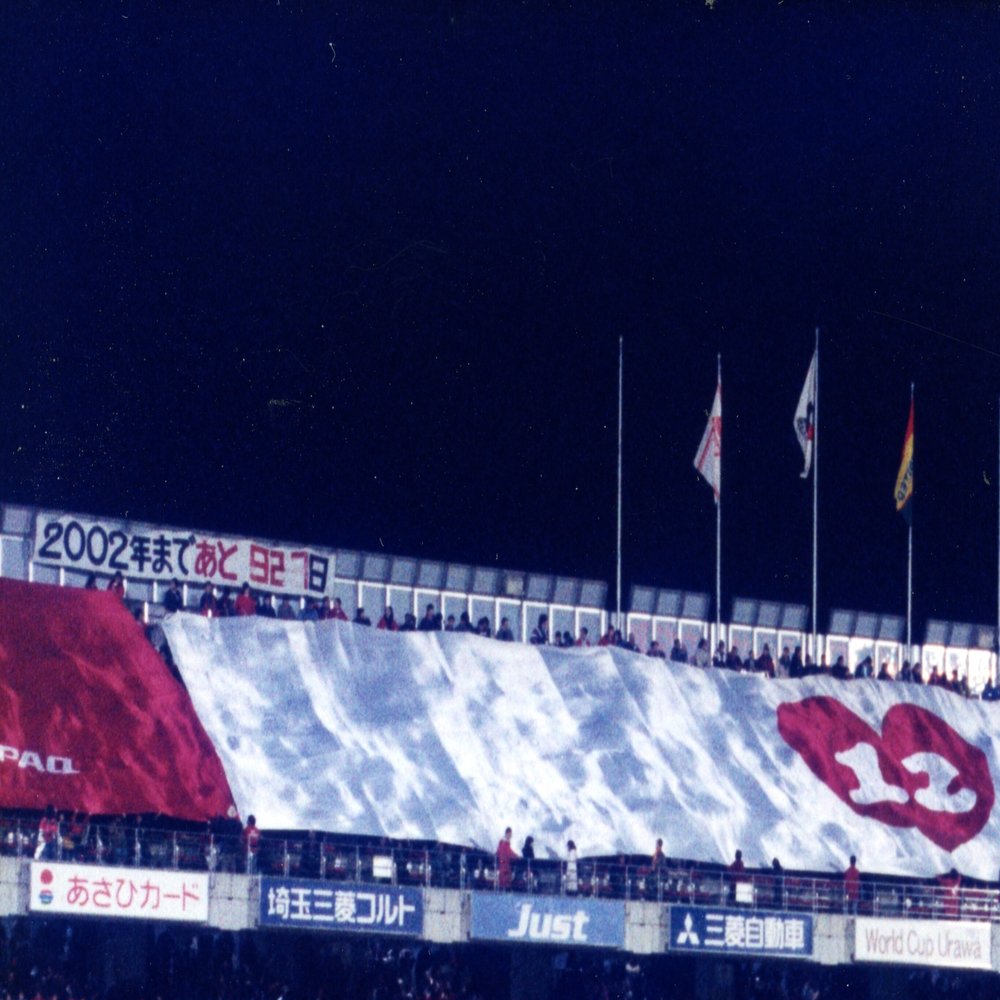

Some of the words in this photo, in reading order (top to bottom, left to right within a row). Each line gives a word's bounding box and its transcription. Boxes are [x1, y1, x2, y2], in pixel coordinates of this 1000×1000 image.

[834, 742, 977, 814] 12
[67, 875, 200, 911] あさひカード
[267, 886, 415, 926] 埼玉三菱コルト
[507, 904, 590, 942] Just
[704, 913, 805, 950] 三菱自動車
[865, 929, 903, 956] World
[907, 931, 934, 962] Cup
[937, 932, 982, 960] Urawa
